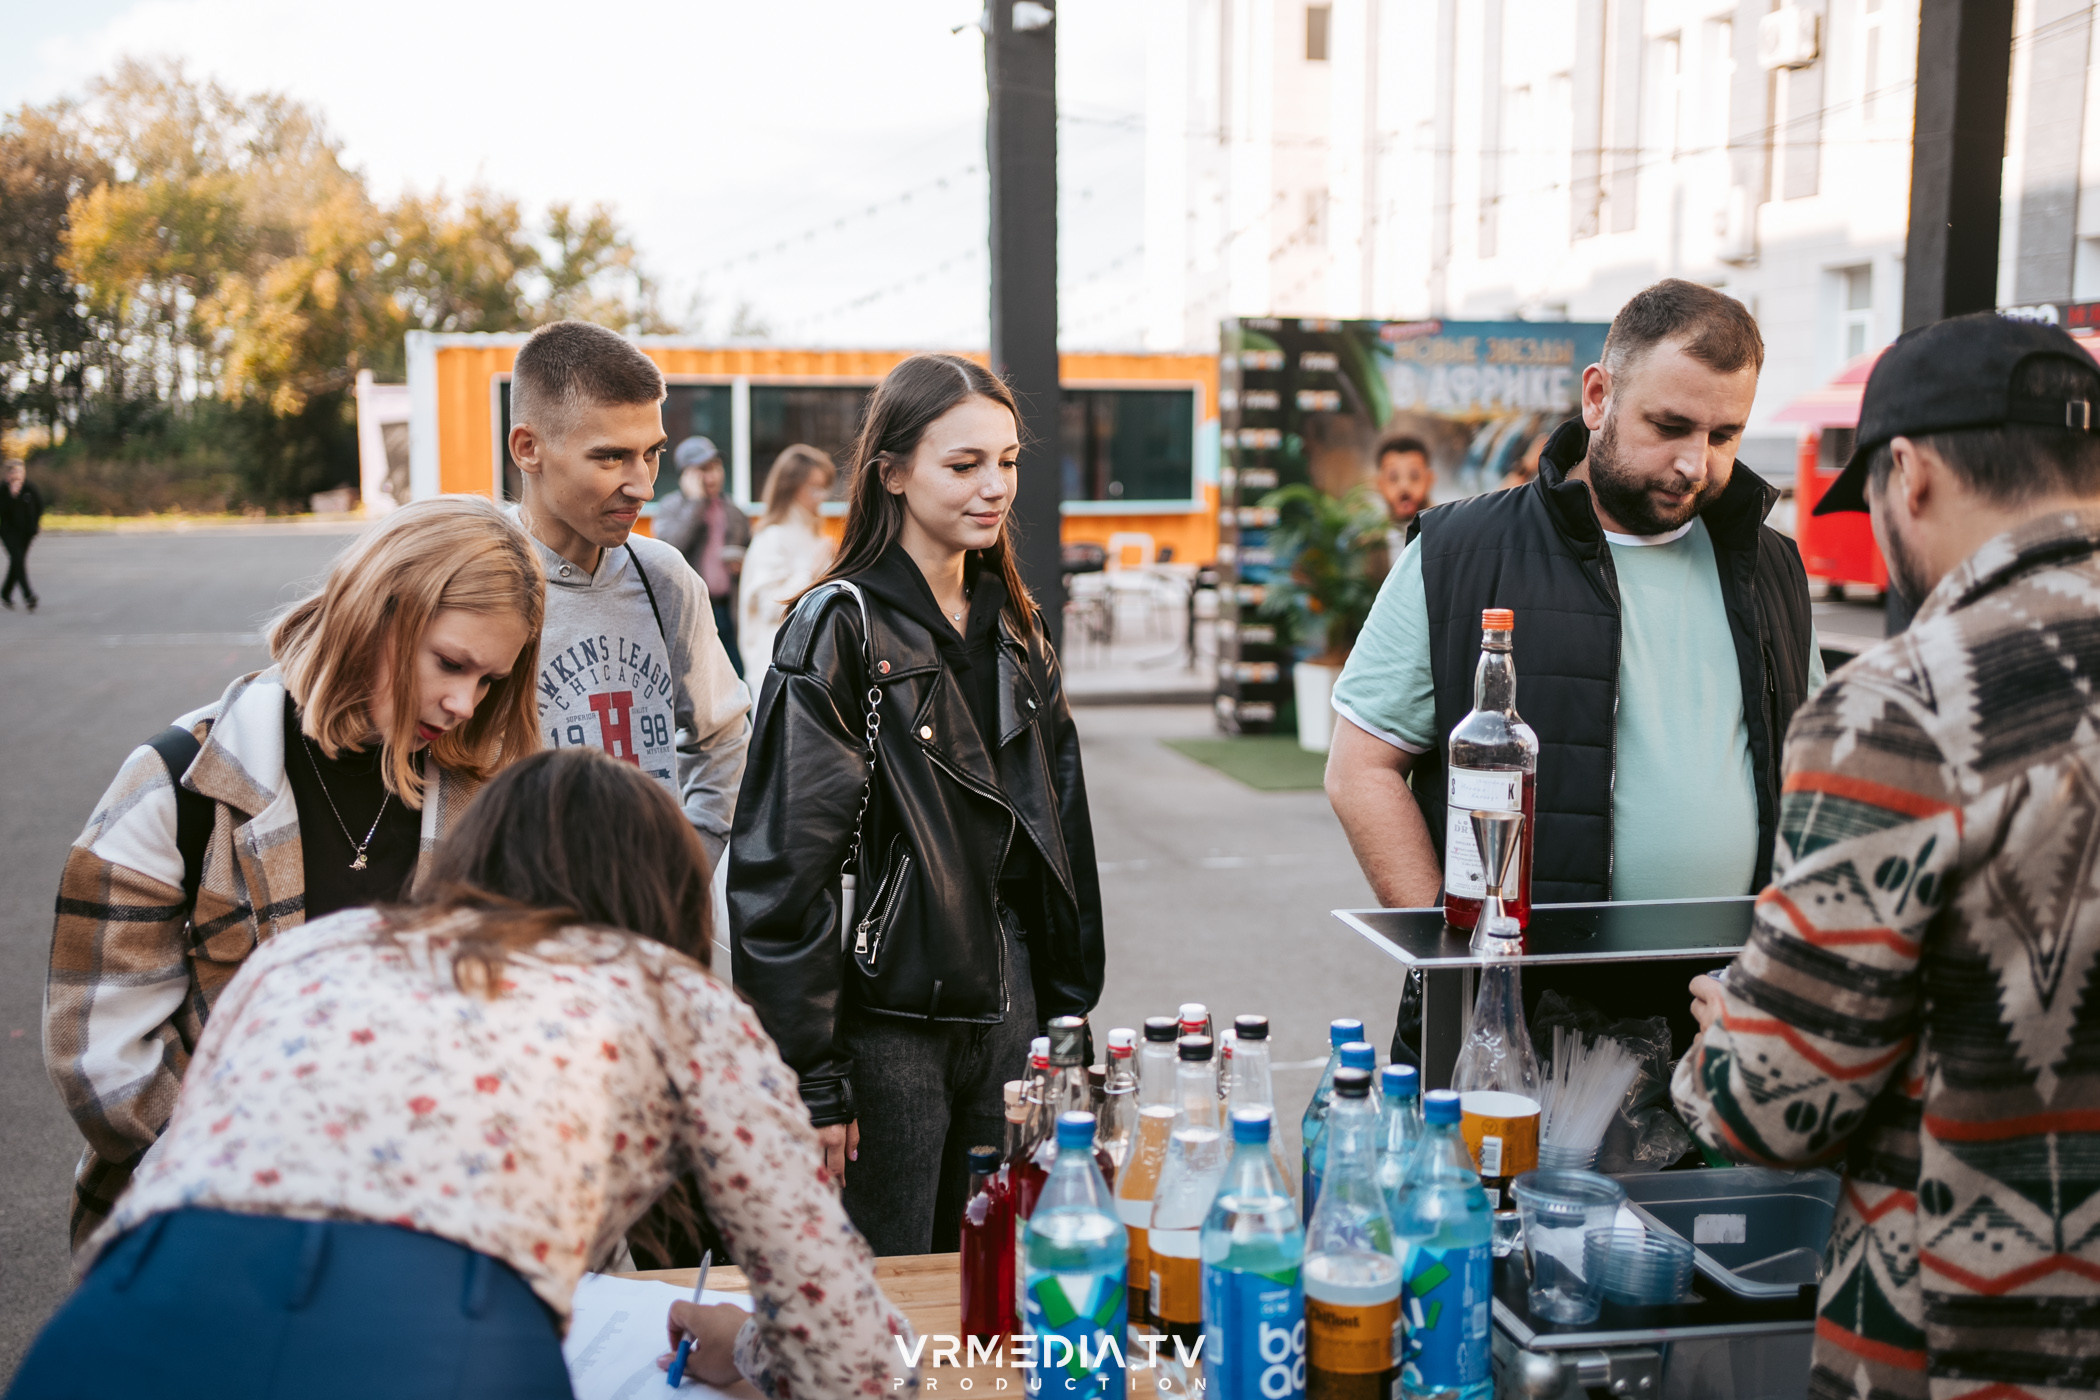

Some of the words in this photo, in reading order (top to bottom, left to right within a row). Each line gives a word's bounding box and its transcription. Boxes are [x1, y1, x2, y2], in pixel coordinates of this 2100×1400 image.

[1486, 336, 1575, 366] ЗВЕЗДЫ
[1424, 364, 1574, 413] АФРИКЕ
[555, 664, 654, 711] CHICAGO
[565, 712, 598, 724] SUPERIOR
[640, 713, 669, 748] 98
[646, 745, 670, 756] MYSTERY
